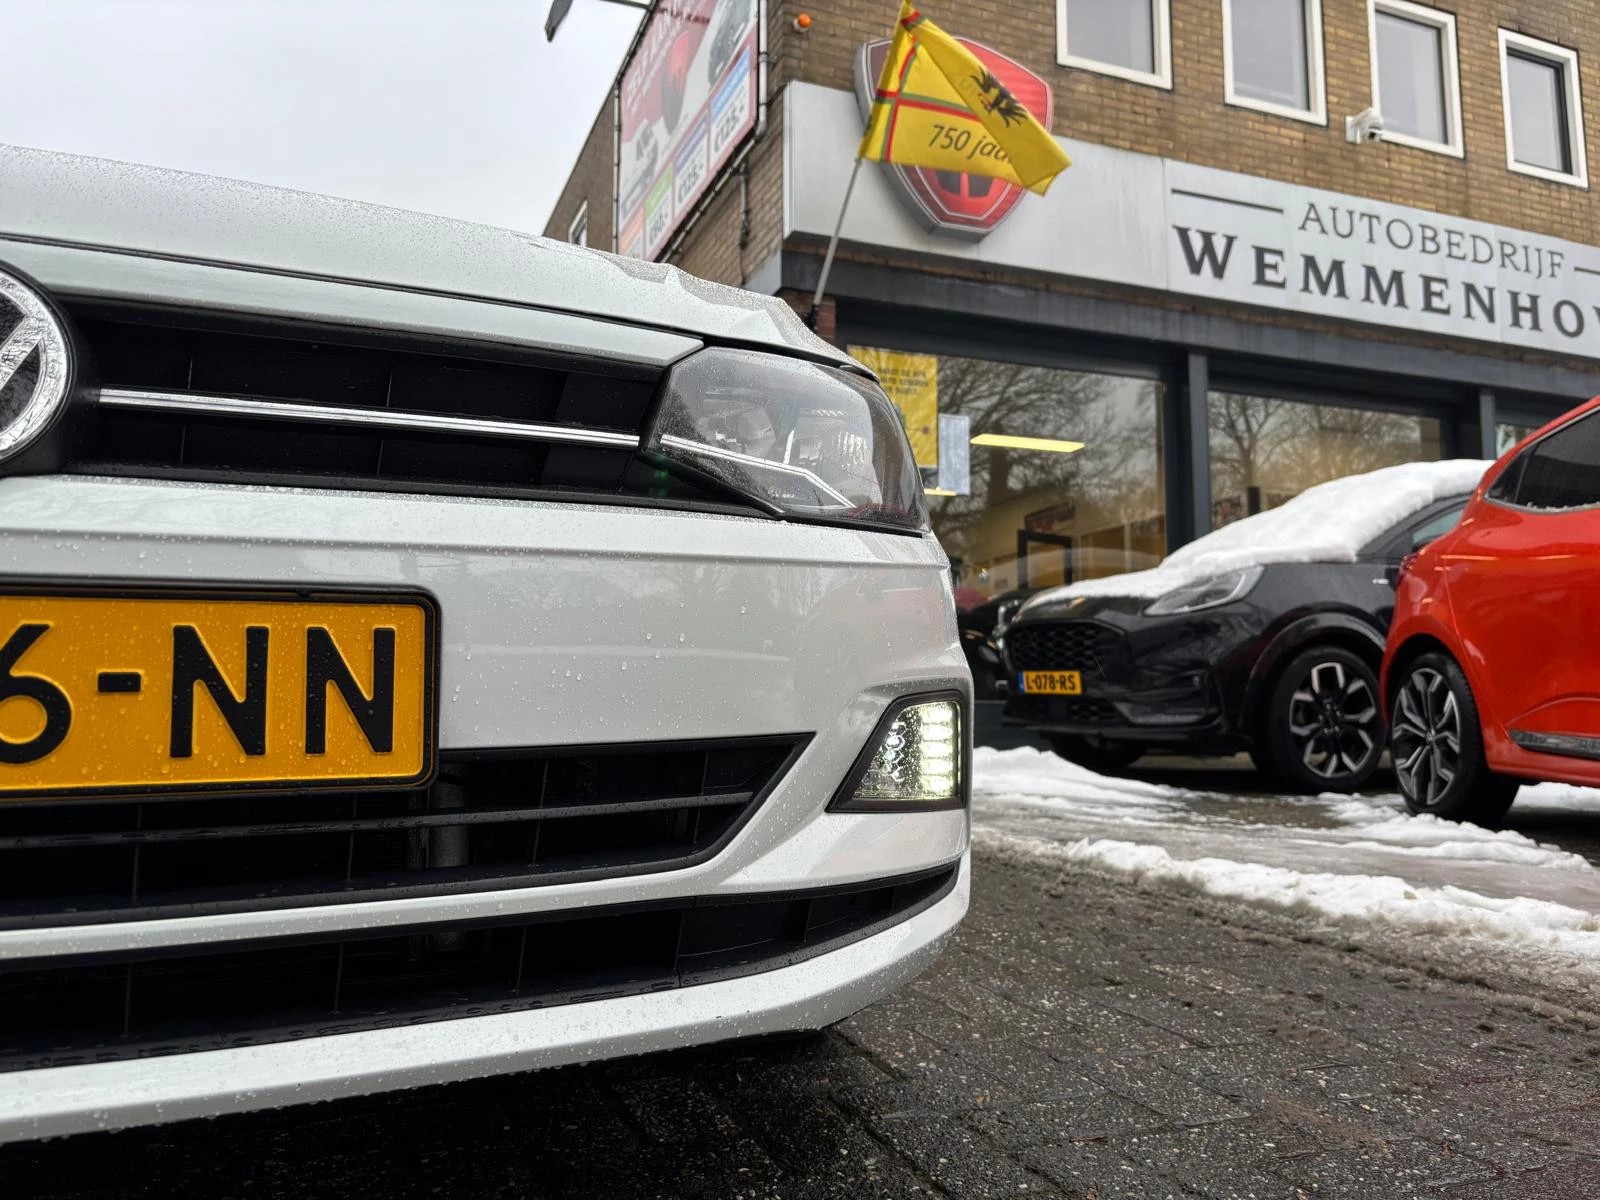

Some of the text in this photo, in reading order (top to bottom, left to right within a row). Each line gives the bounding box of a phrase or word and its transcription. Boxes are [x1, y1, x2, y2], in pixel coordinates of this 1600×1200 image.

[928, 125, 1011, 161] 750 jaa
[1298, 202, 1565, 280] AUTOBEDRIJF
[1025, 674, 1076, 690] L-078-RS
